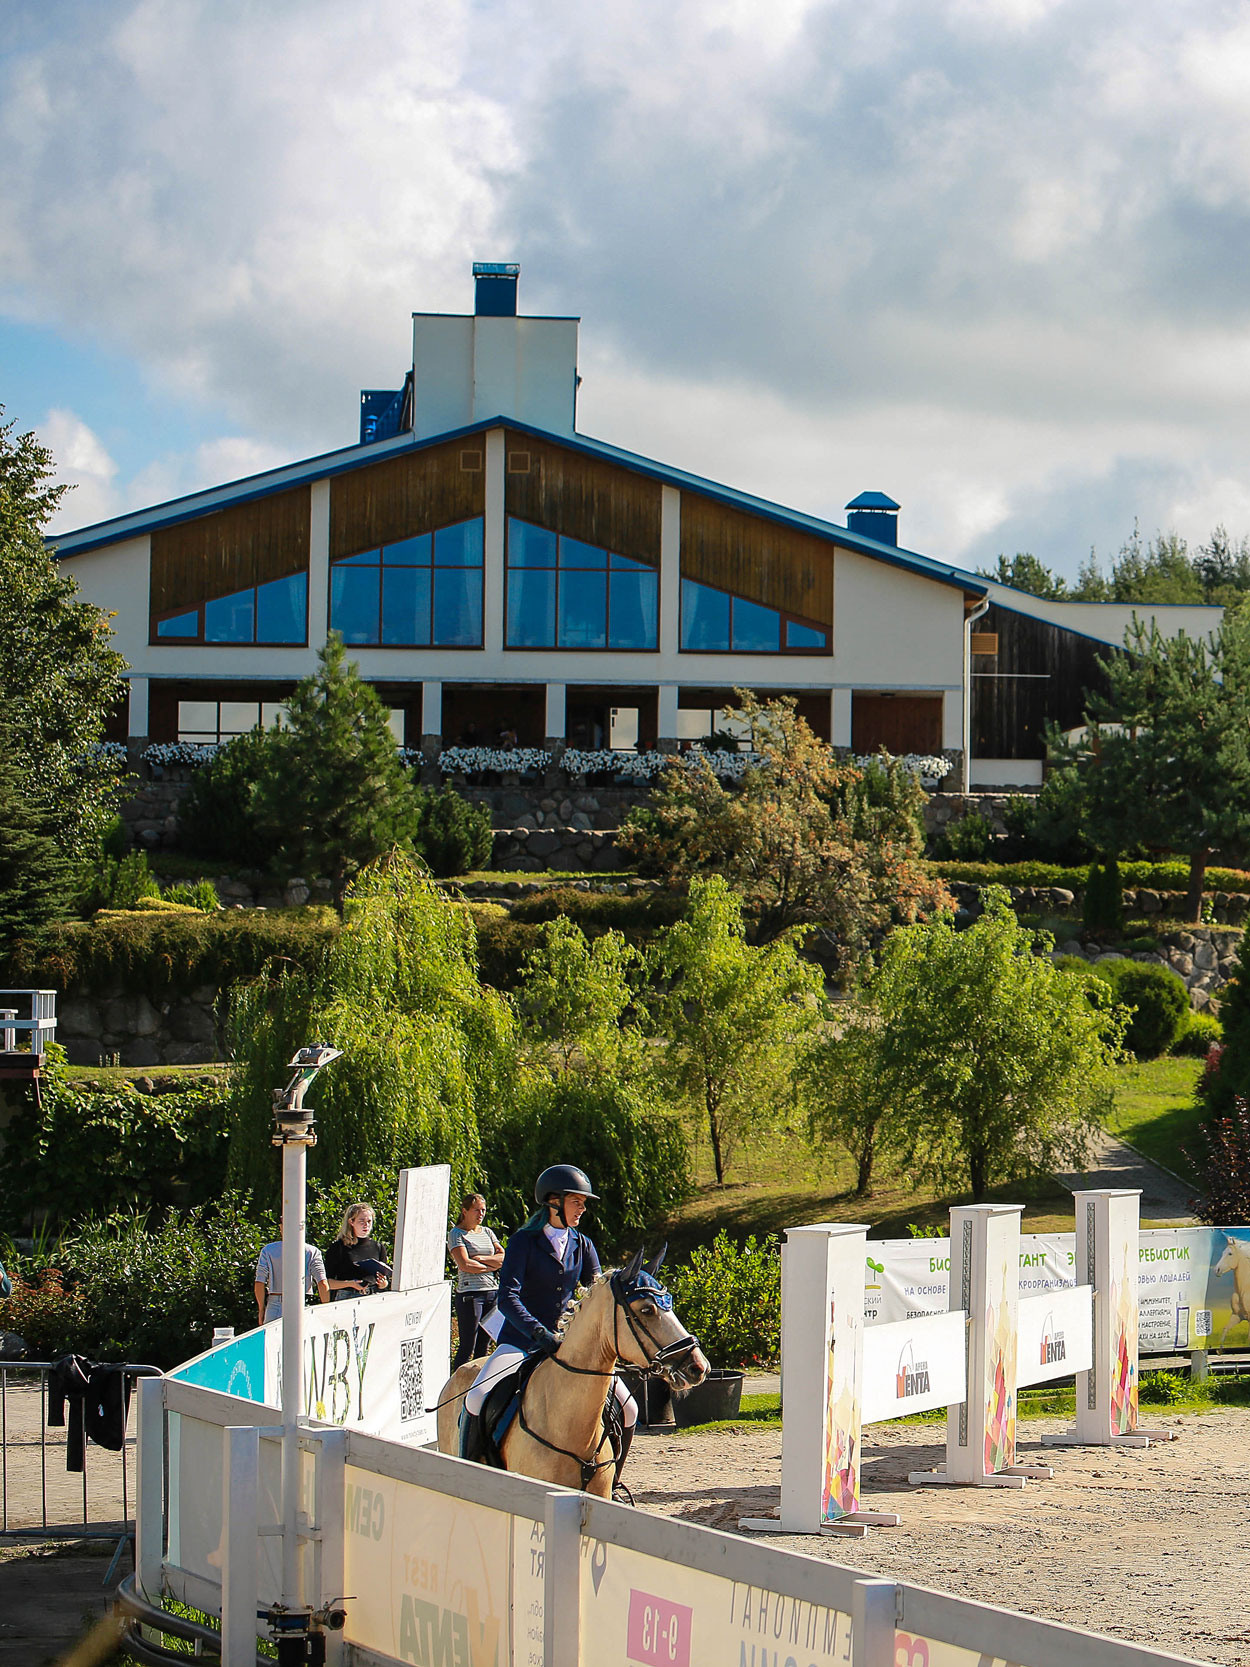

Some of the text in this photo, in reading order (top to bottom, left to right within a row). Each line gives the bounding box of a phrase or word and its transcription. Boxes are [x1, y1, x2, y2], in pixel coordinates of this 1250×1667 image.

[1018, 1252, 1047, 1268] ГАНТ
[1138, 1246, 1190, 1263] РЕБИОТИК
[904, 1284, 947, 1296] НА ОСНОВЕ
[1018, 1278, 1077, 1290] КРООРГАНИЗМОВ
